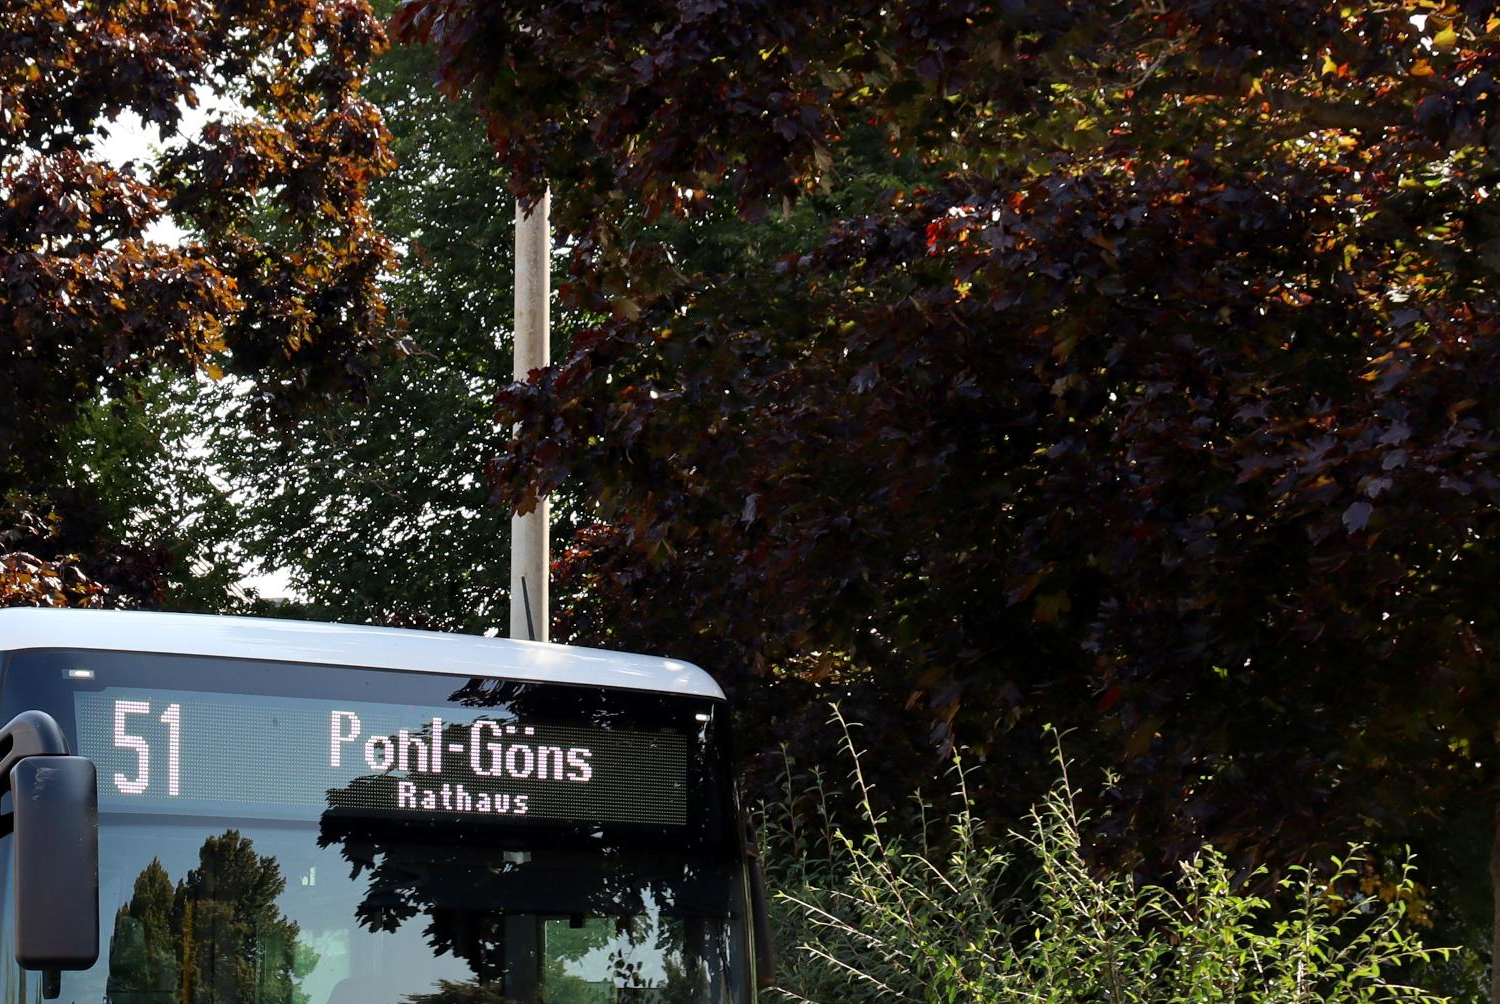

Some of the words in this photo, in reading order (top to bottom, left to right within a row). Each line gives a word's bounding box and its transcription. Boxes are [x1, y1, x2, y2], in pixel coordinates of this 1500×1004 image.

[114, 700, 181, 796] 51
[330, 710, 593, 781] Pohl-Göns
[398, 781, 529, 814] Rathaus
